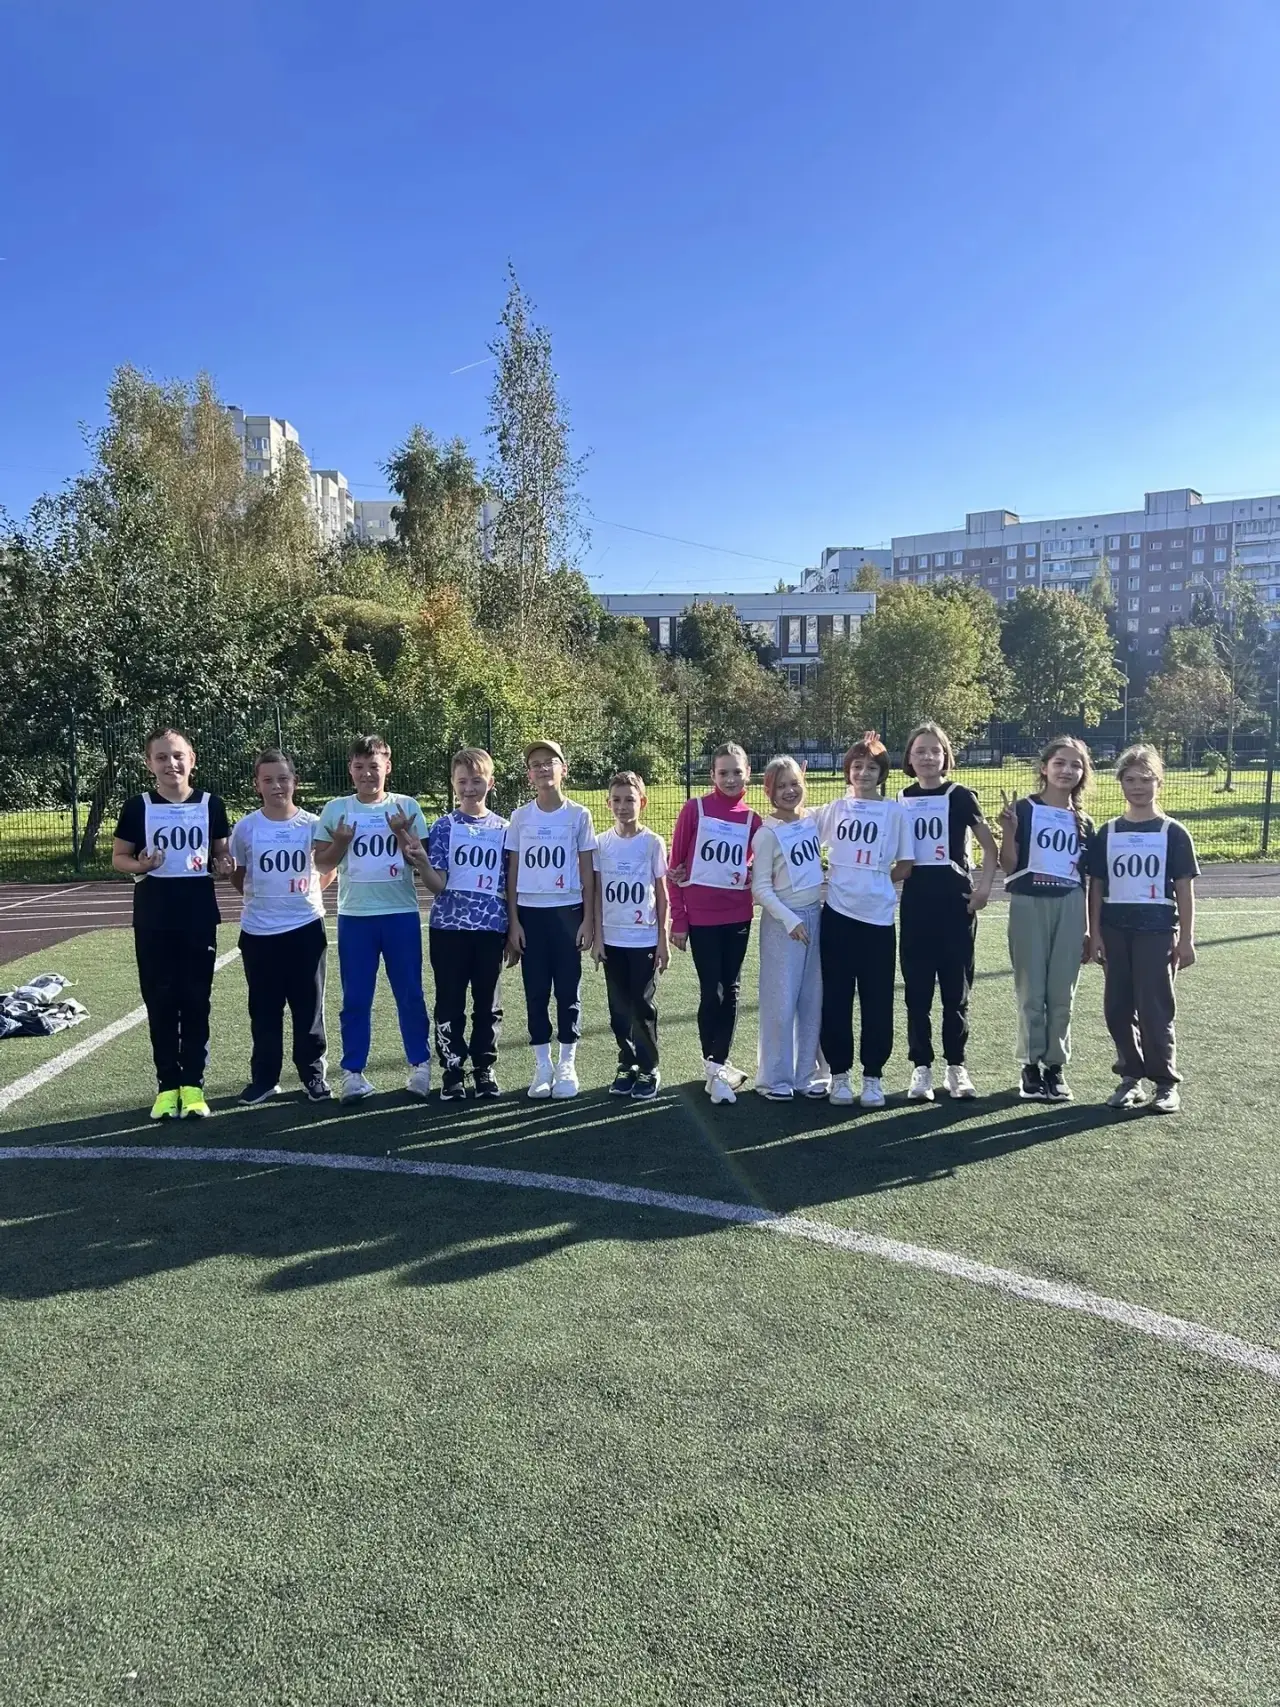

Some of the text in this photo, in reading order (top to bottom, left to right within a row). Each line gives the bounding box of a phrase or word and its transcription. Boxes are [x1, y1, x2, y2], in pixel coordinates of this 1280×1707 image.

[153, 826, 203, 851] 600
[837, 818, 878, 844] 600
[914, 816, 943, 840] 00
[353, 833, 398, 858] 600
[701, 839, 743, 866] 600
[790, 835, 821, 866] 600
[935, 845, 945, 861] 5
[1037, 827, 1079, 855] 600
[192, 856, 203, 872] 8
[259, 849, 306, 873] 600
[454, 844, 497, 870] 600
[525, 845, 566, 869] 600
[856, 849, 872, 865] 11
[1069, 861, 1077, 876] 7
[1112, 853, 1160, 878] 600
[389, 863, 399, 877] 6
[477, 874, 493, 890] 12
[555, 874, 564, 889] 4
[730, 871, 741, 886] 3
[288, 878, 308, 894] 10
[605, 880, 645, 905] 600
[1149, 884, 1156, 899] 1
[634, 910, 643, 925] 2
